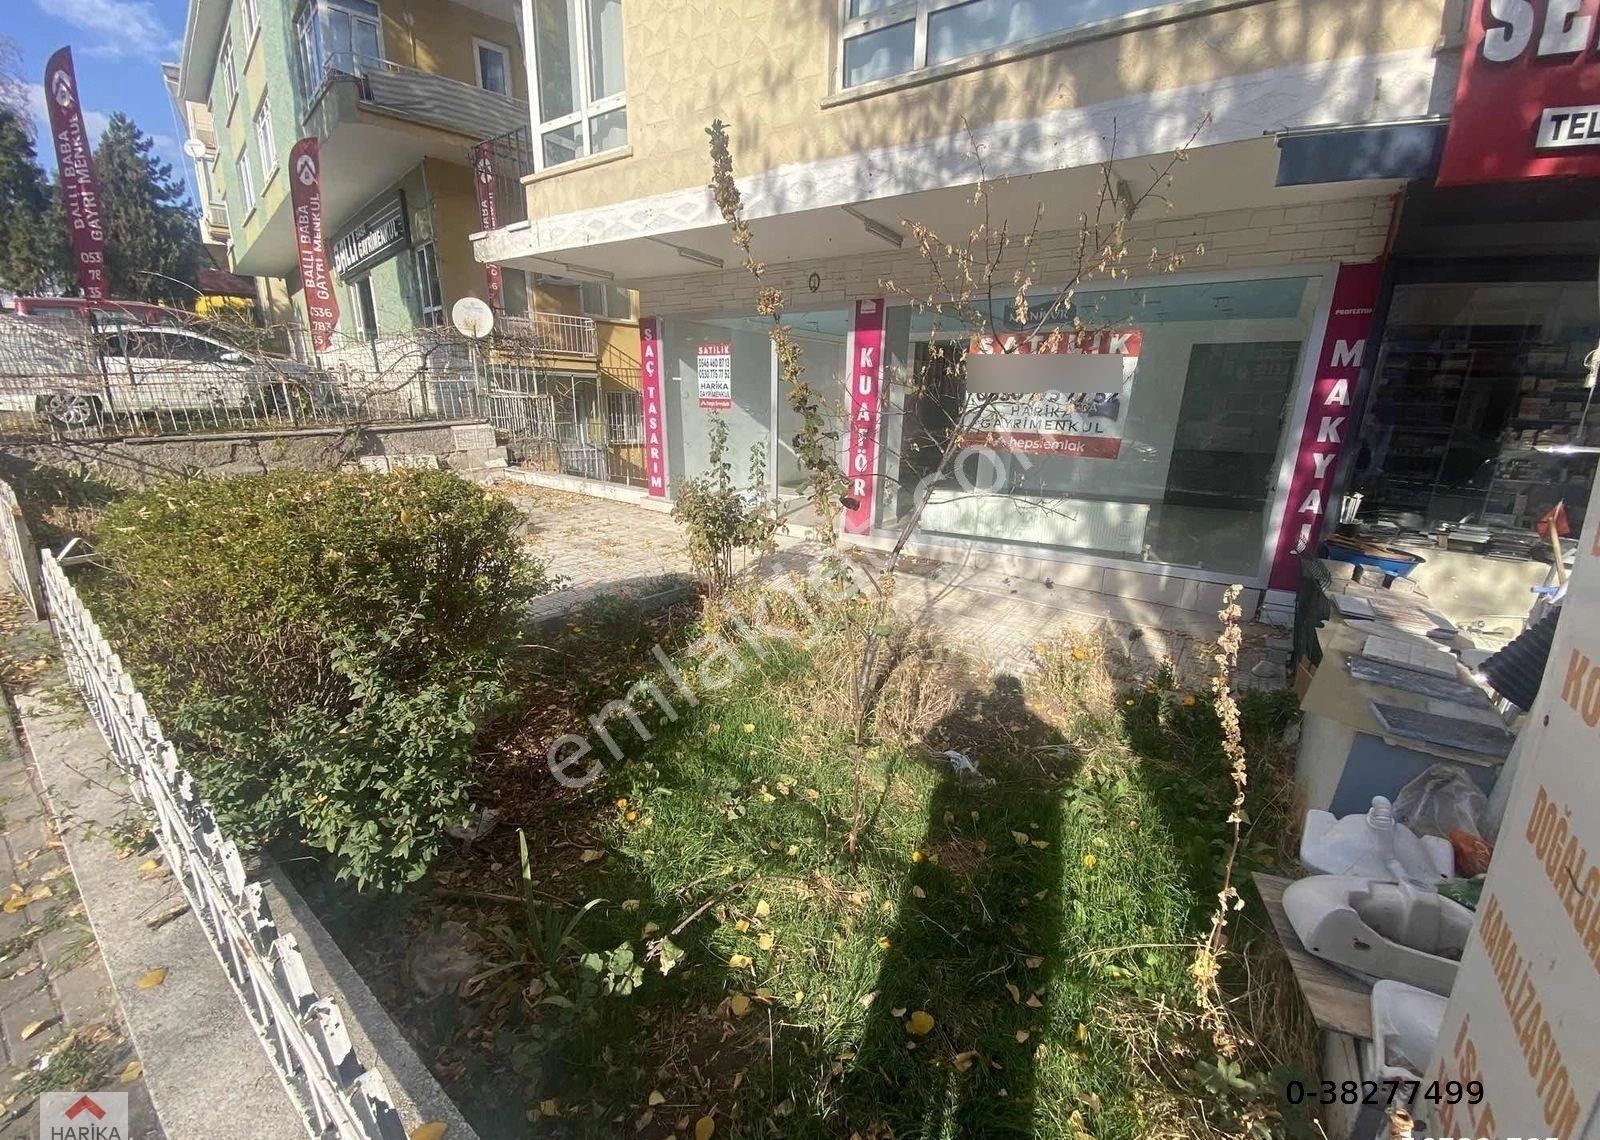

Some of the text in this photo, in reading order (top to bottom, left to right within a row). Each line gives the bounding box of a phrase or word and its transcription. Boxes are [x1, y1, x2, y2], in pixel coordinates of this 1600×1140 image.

[58, 130, 85, 230] BALLI BABA
[69, 112, 92, 184] MENKUL
[298, 204, 316, 288] BALLI BABA
[310, 192, 322, 252] MENKUL
[698, 346, 730, 355] SATILIK
[700, 380, 729, 390] HARİKA
[644, 328, 662, 489] SAÇ TASARIM
[853, 347, 874, 497] KUAFÖR
